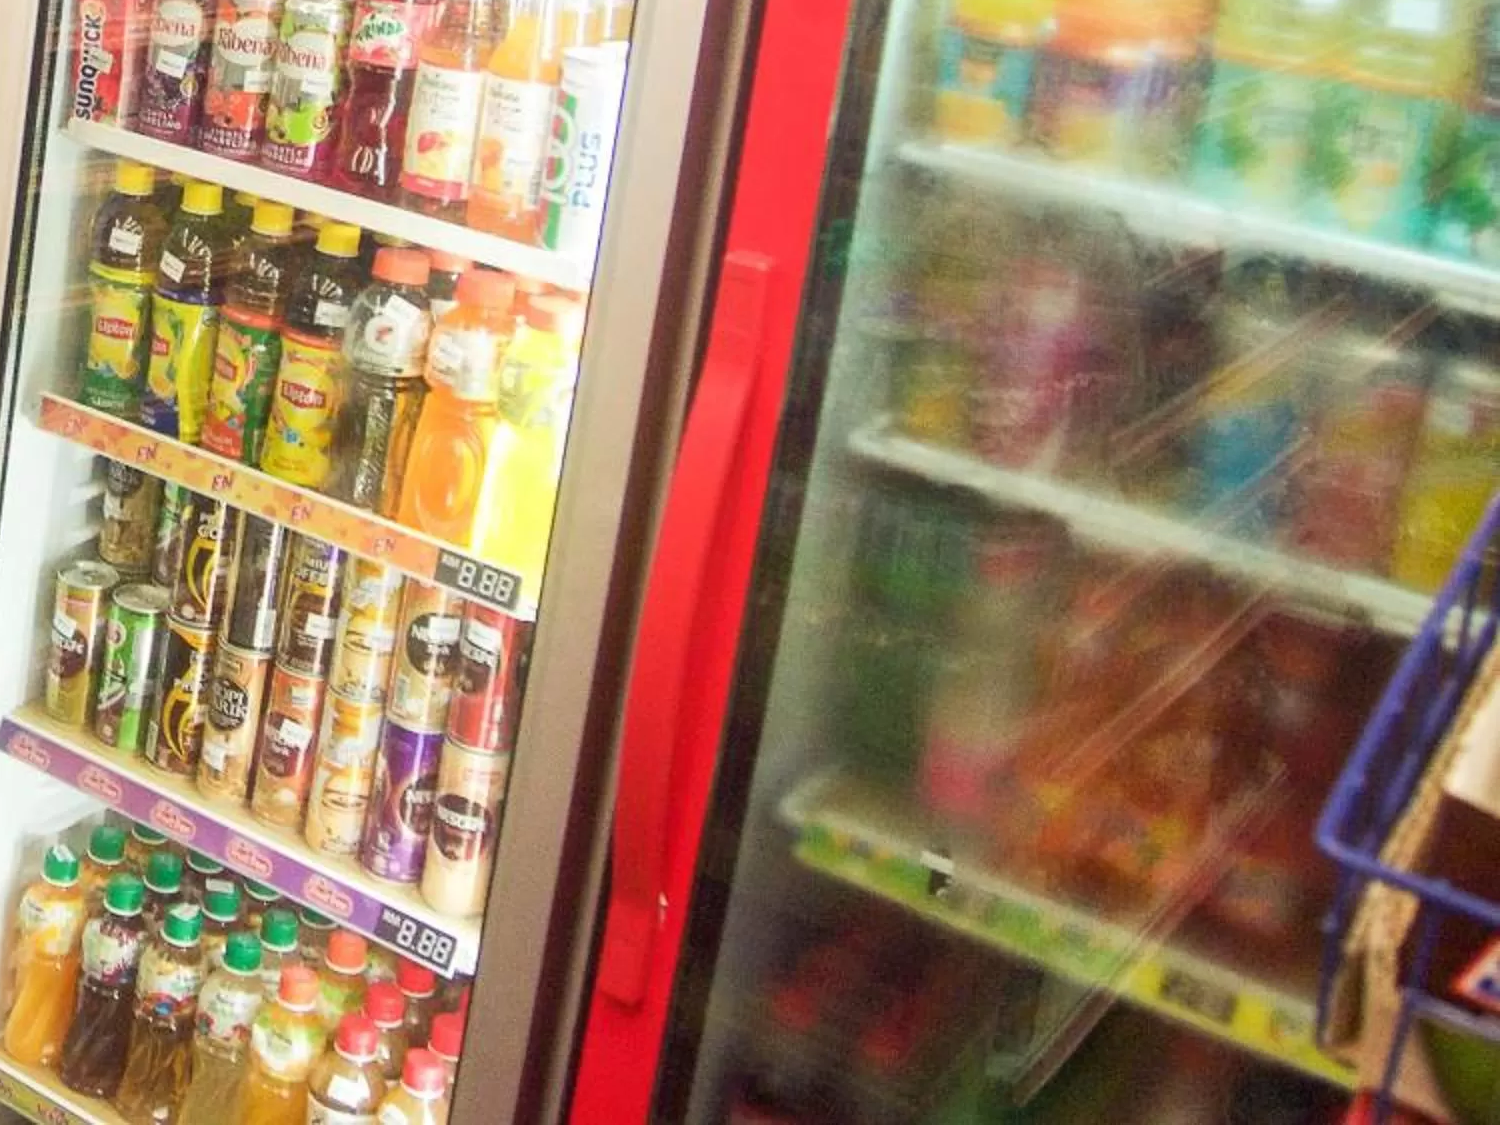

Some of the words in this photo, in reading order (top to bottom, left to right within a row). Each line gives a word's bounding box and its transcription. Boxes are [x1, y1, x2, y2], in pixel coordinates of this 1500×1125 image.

[76, 14, 103, 121] SUNQICK
[98, 320, 133, 338] Lipton
[282, 383, 326, 407] Lipton
[457, 557, 516, 603] 8.88
[396, 919, 453, 964] 8.88
